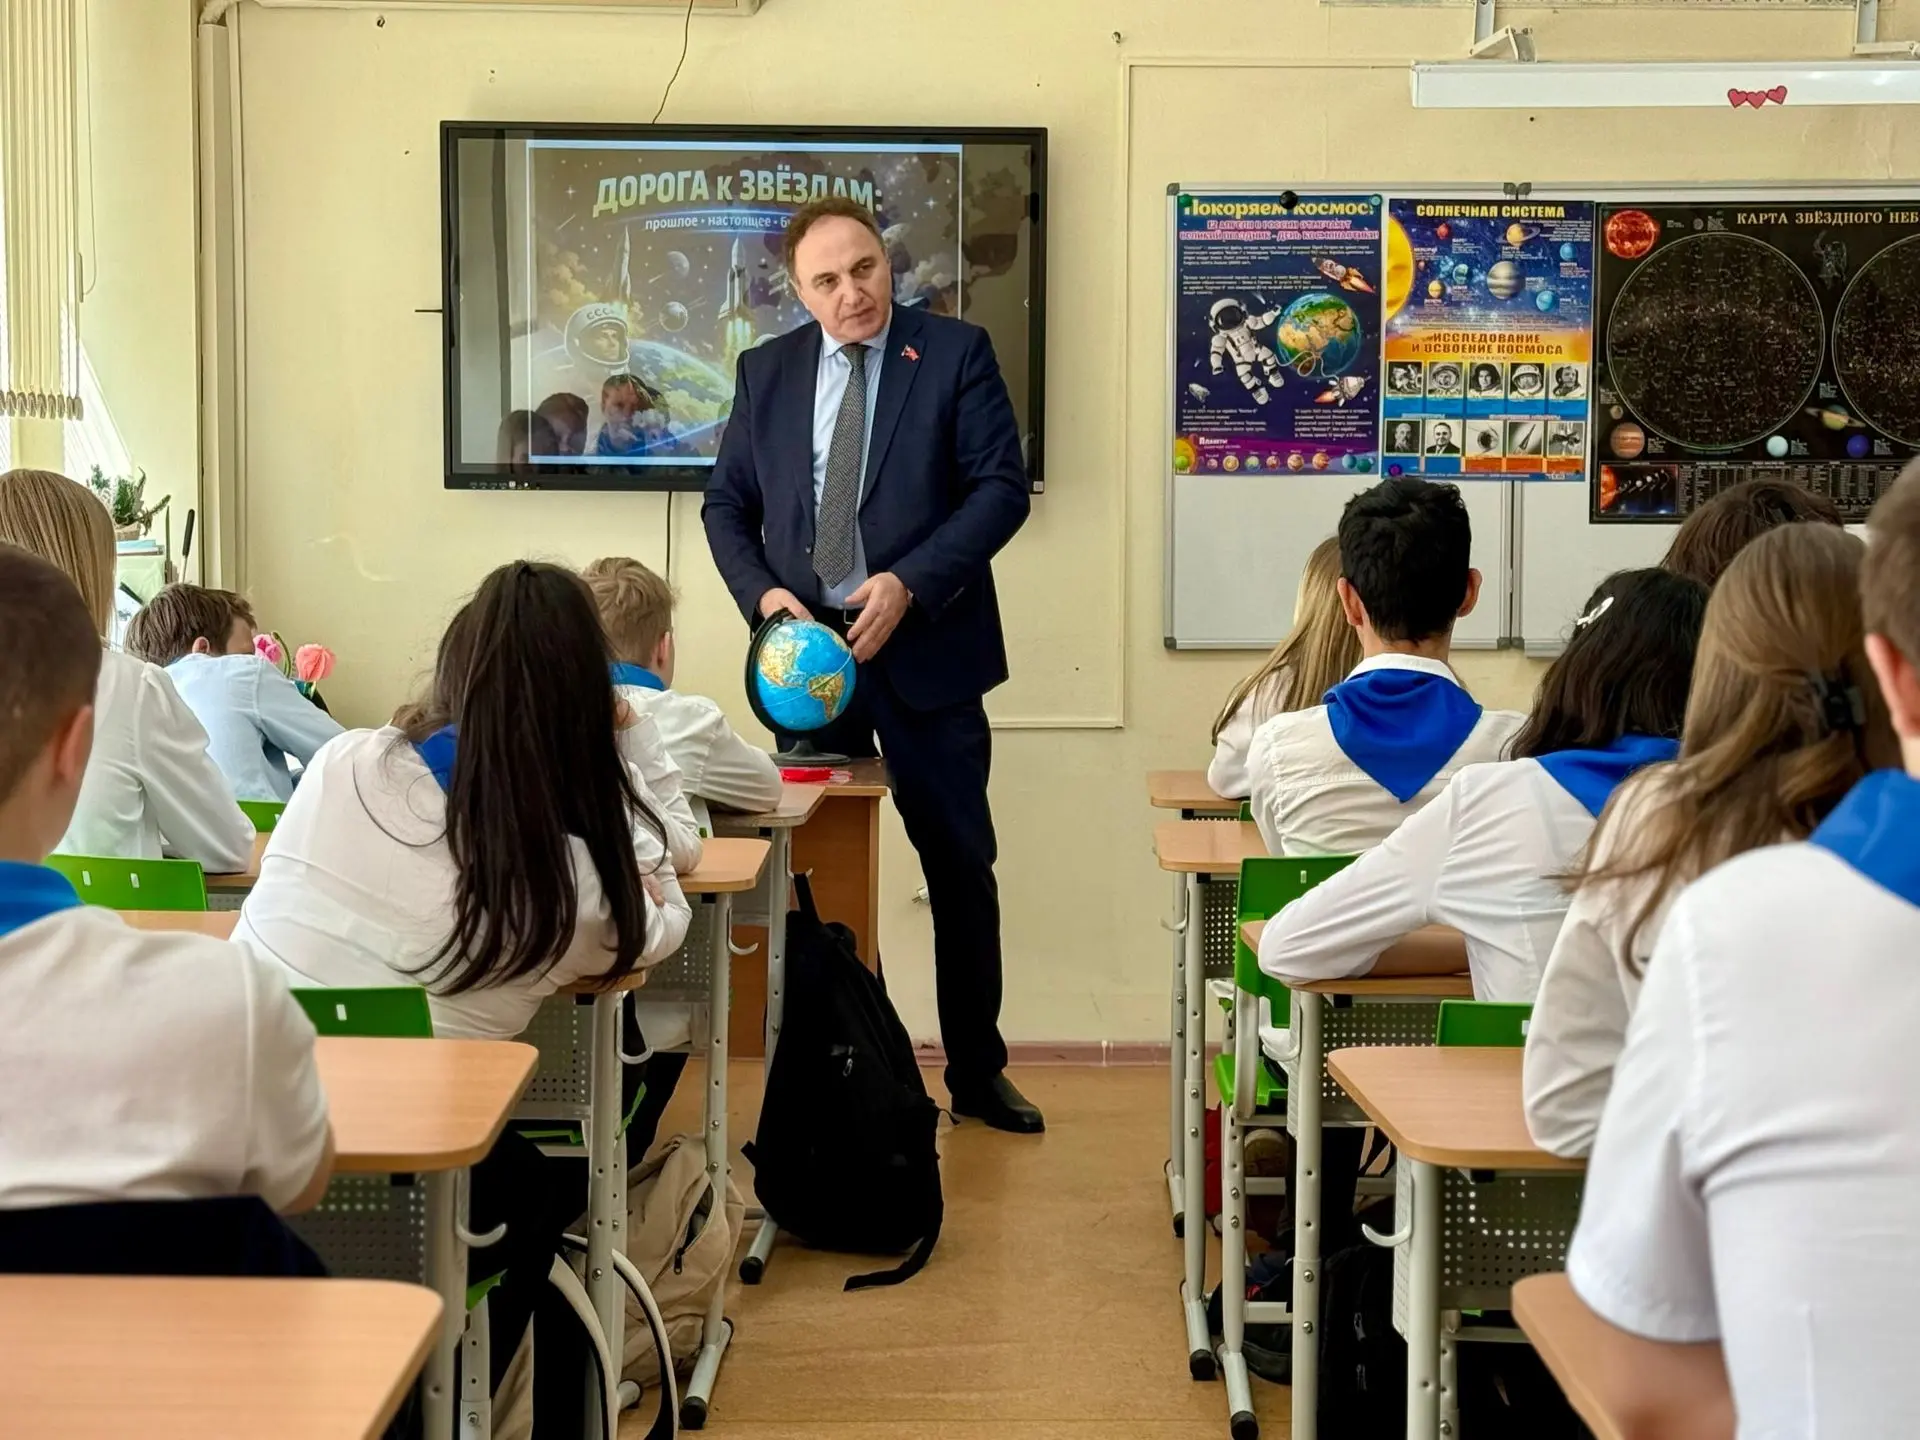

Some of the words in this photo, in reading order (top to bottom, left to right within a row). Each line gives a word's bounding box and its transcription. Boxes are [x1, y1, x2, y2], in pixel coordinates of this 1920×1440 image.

[592, 169, 710, 218] ДОРОГА
[739, 163, 883, 214] ЗВЁЗДАМ:
[1184, 199, 1288, 219] Покоряем
[1416, 204, 1498, 217] СОЛНЕЧНАЯ
[1501, 205, 1565, 218] СИСТЕМА
[645, 216, 698, 231] прошлое
[708, 215, 771, 229] настоящее
[1736, 212, 1788, 225] КАРТА
[1795, 210, 1883, 226] ЗВЁЗДНОГО
[1888, 211, 1920, 224] НЕБ
[1433, 333, 1541, 344] ИССЛЕДОВАНИЕ
[1411, 343, 1420, 353] И
[1424, 343, 1492, 354] ОСВОЕНИЕ
[1497, 344, 1563, 355] КОСМОСА
